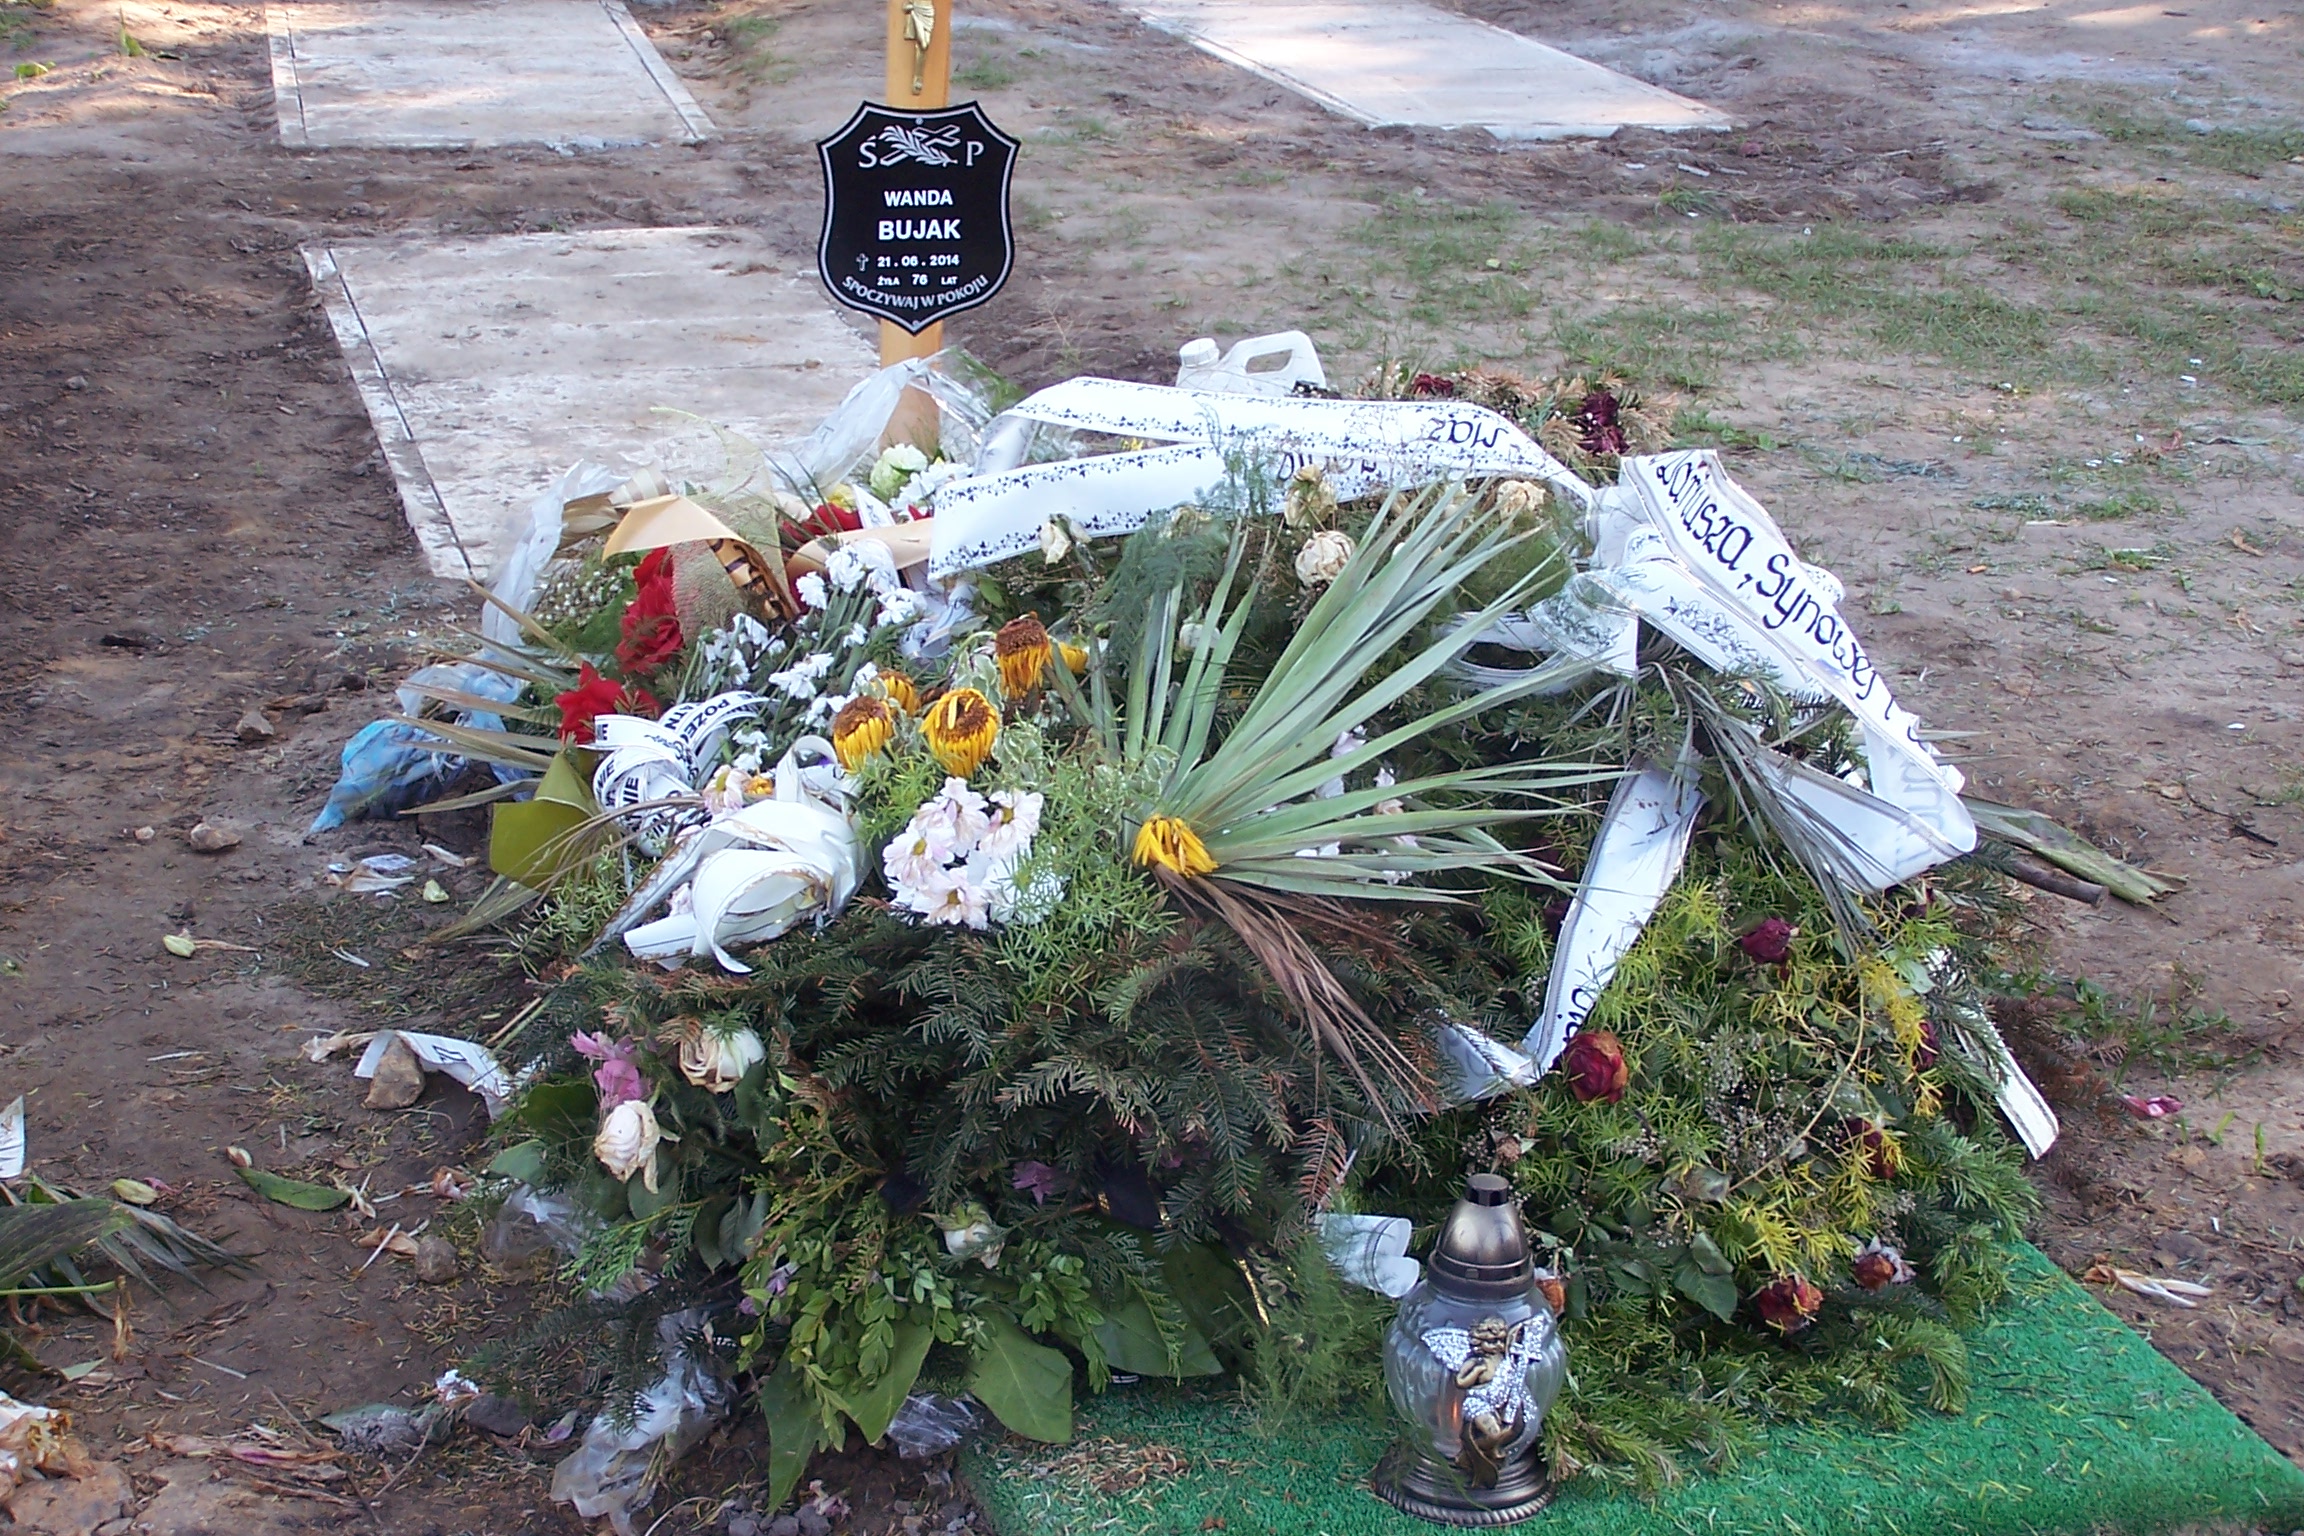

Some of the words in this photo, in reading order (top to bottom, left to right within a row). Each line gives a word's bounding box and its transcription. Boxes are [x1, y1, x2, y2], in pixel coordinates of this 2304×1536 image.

[965, 141, 985, 166] P
[884, 190, 953, 207] WANDA
[878, 219, 961, 240] BUJAK
[912, 274, 928, 285] 76
[941, 276, 958, 285] LAT
[842, 276, 918, 310] SPOCZYWAJ
[920, 296, 935, 307] W
[937, 274, 989, 305] POKOJU
